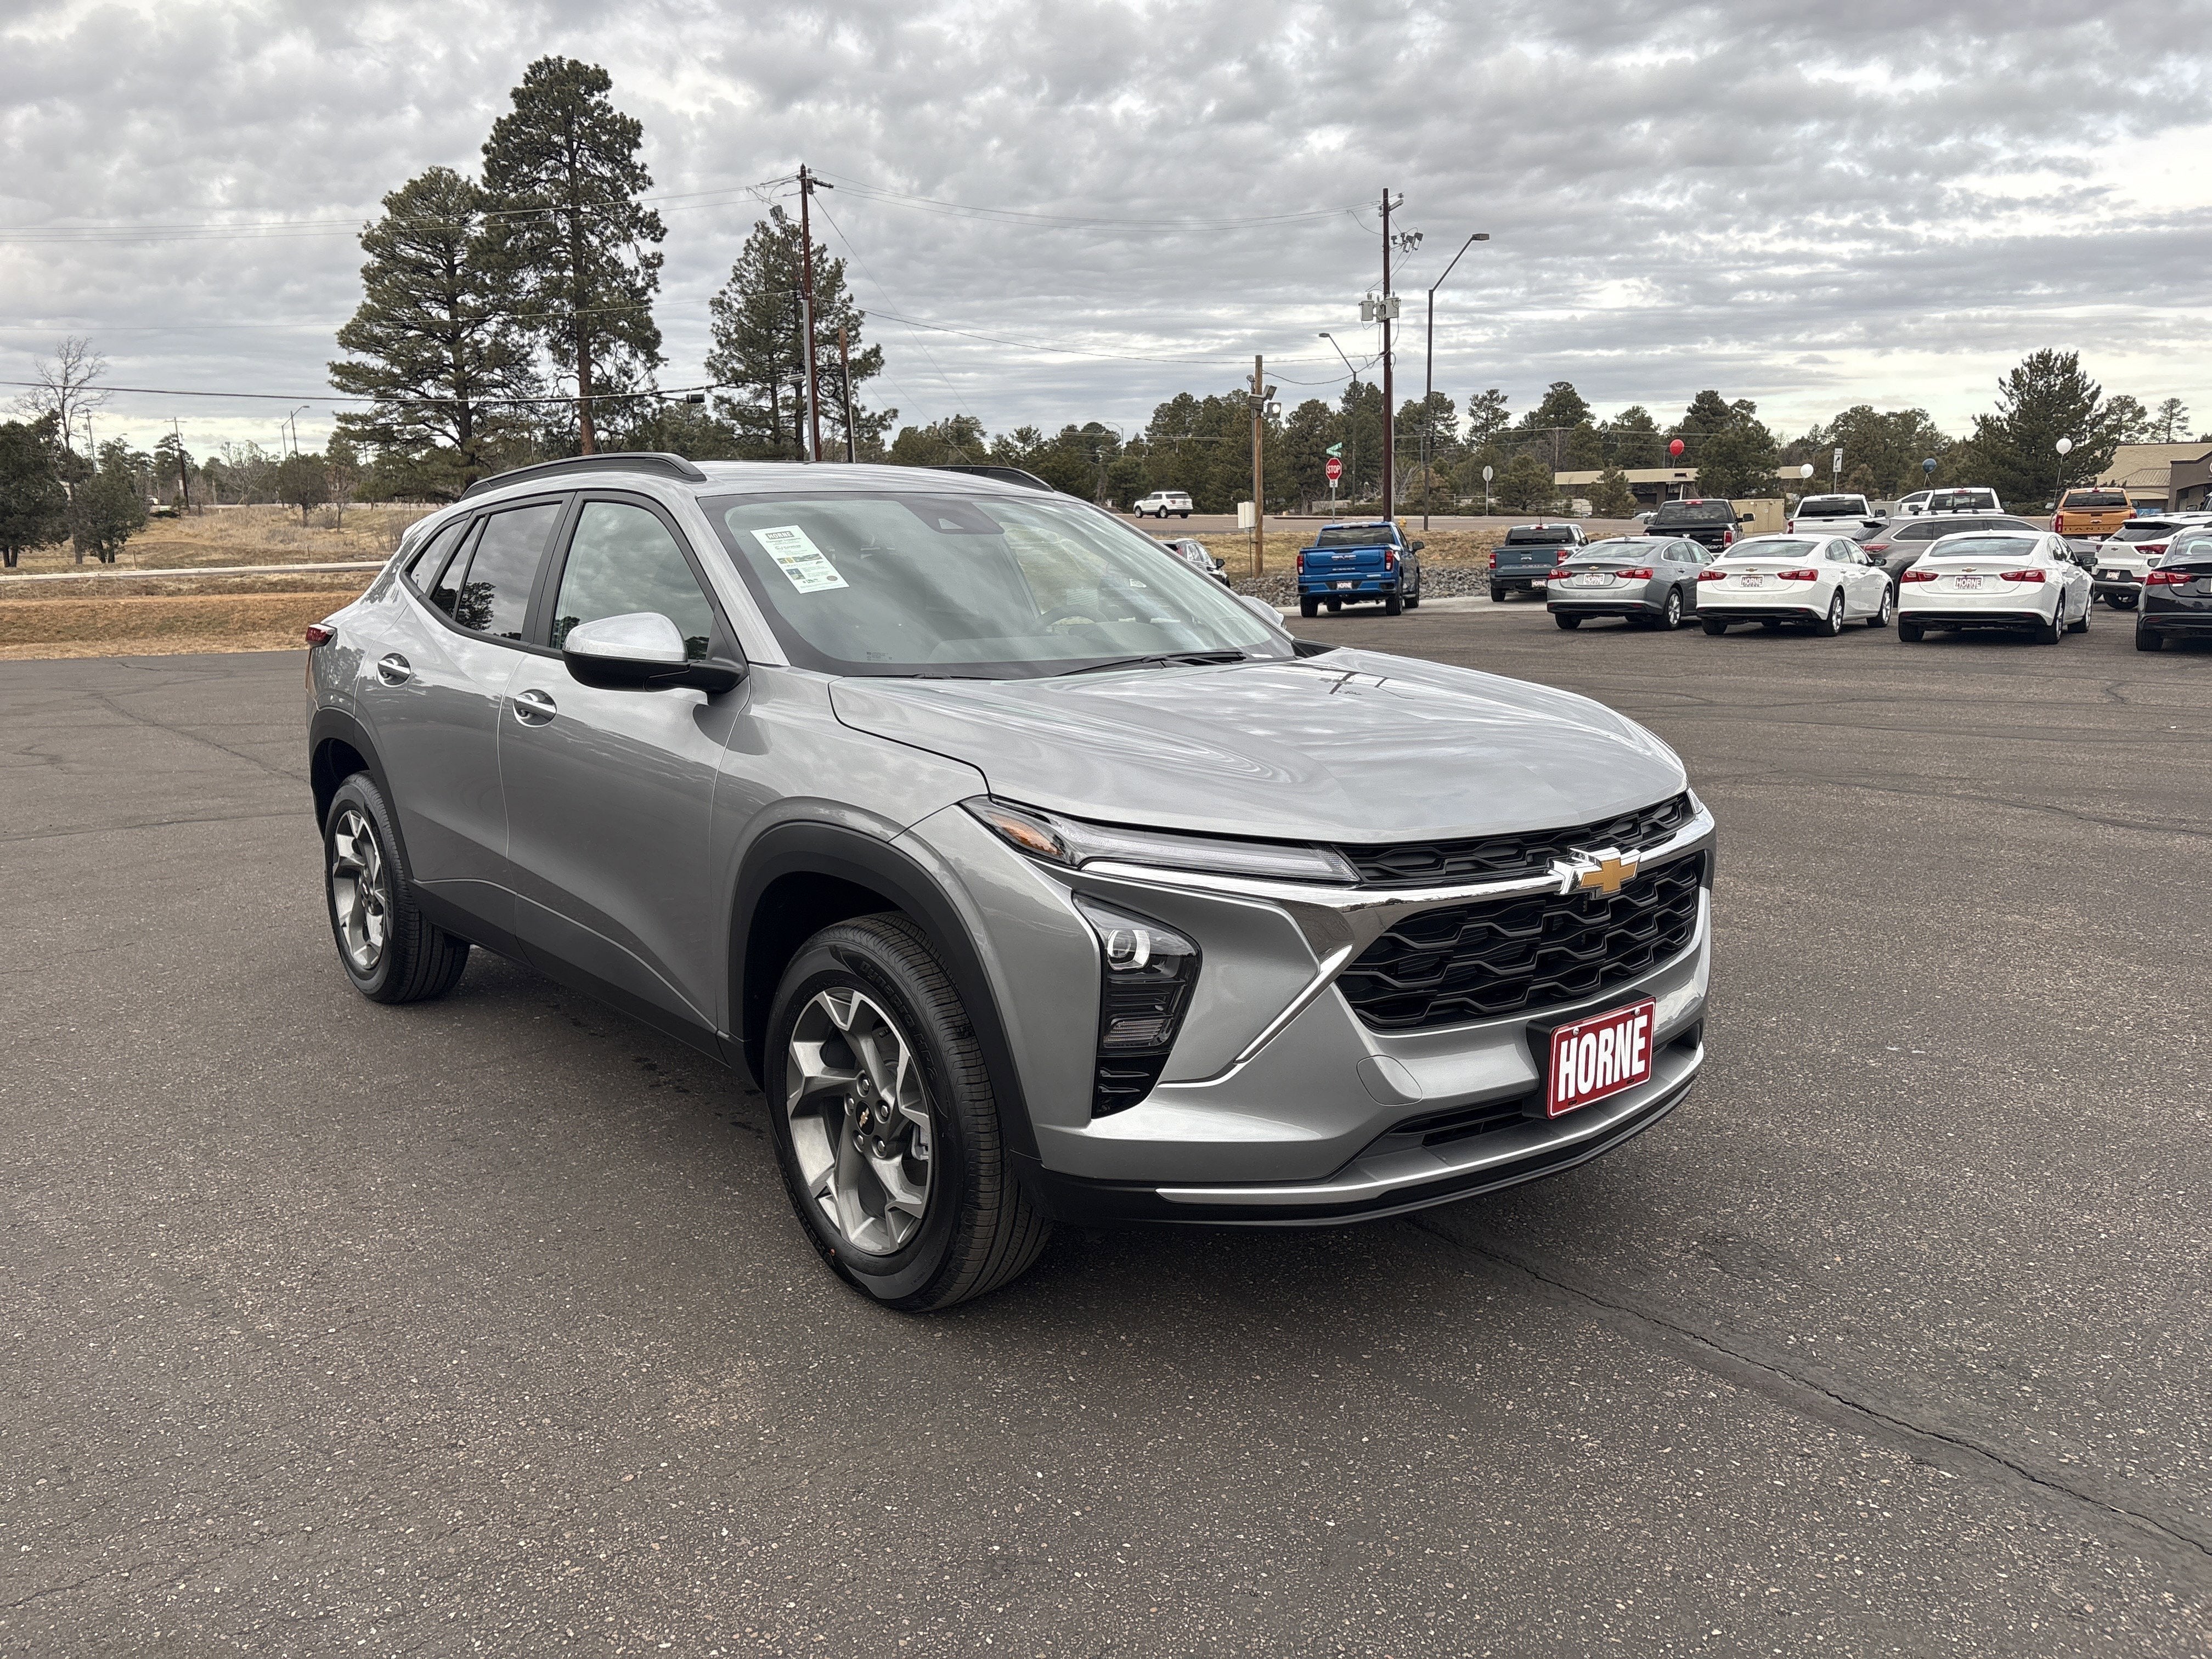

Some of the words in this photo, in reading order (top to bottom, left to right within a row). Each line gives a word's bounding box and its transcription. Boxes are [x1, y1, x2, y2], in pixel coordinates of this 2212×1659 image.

[1327, 465, 1341, 474] STOP
[1956, 578, 1981, 586] HORNE
[1558, 1014, 1648, 1102] HORNE
